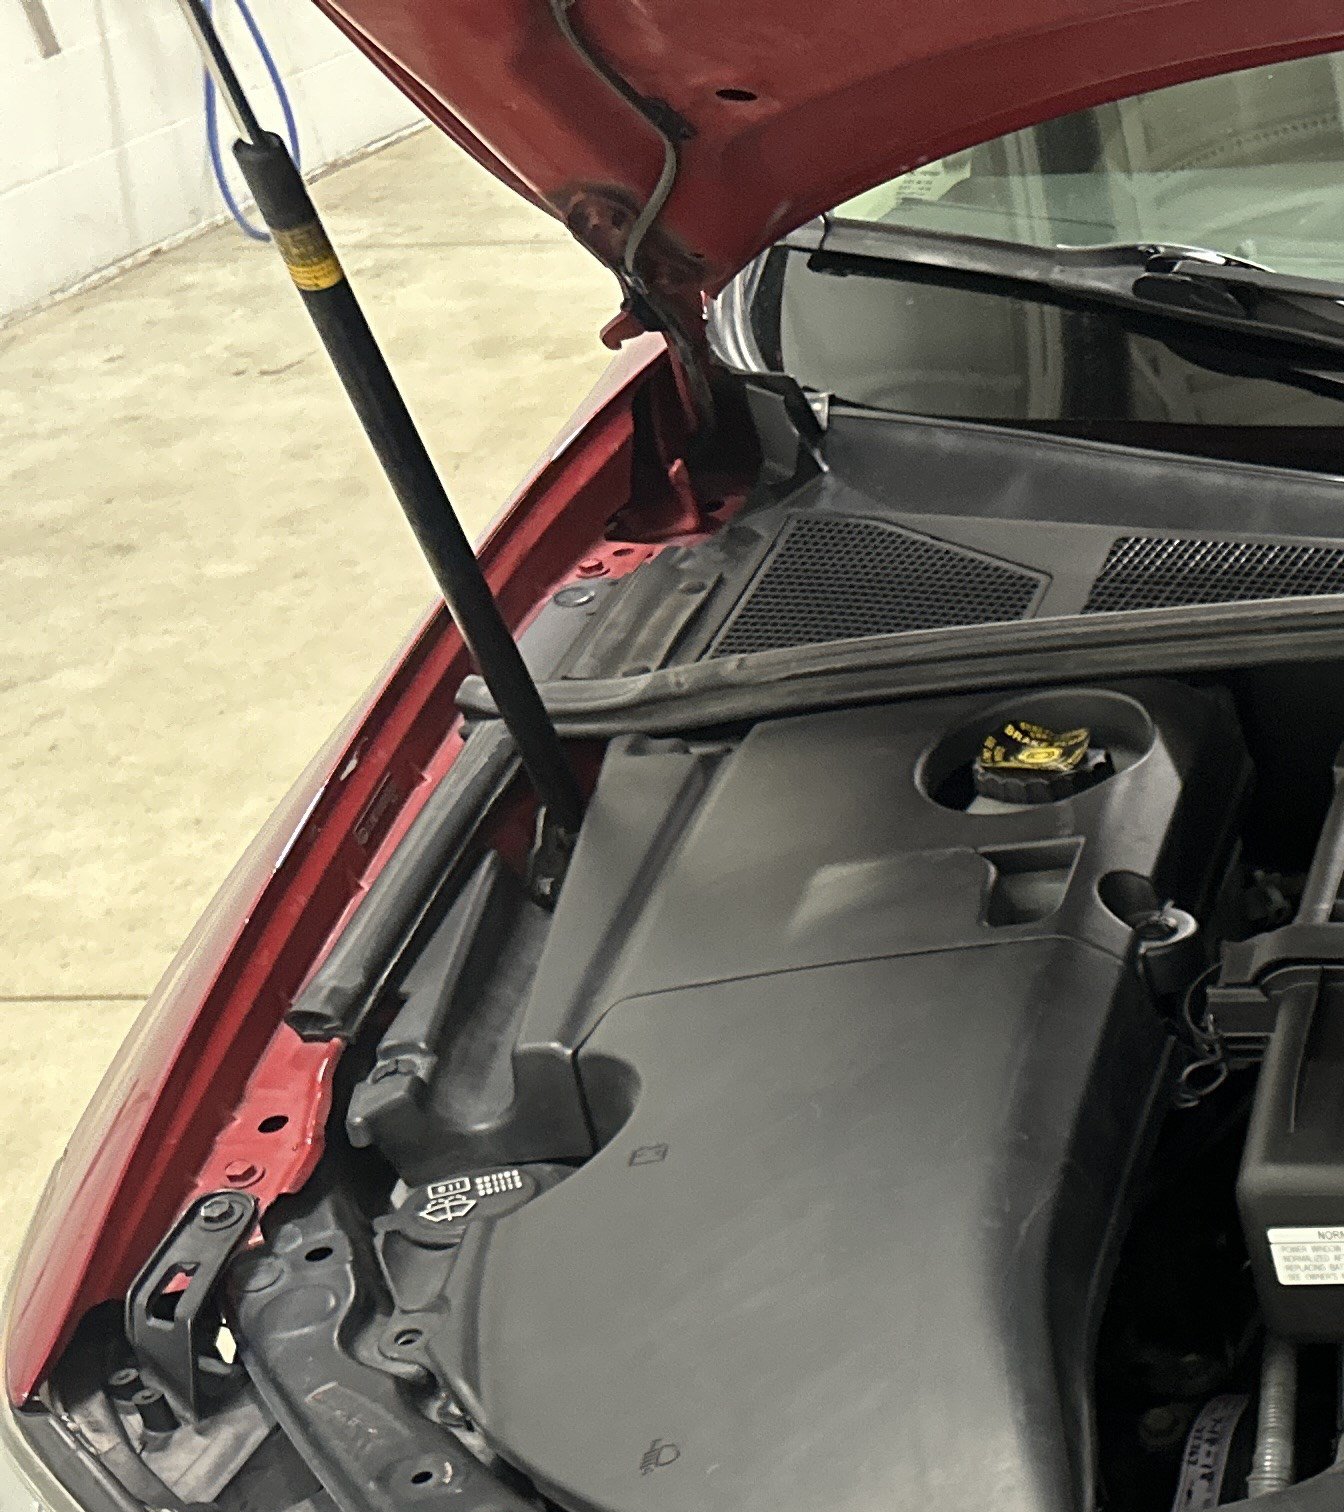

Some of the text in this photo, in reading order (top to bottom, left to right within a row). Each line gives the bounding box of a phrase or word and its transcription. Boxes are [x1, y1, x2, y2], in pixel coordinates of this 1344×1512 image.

[1281, 1244, 1308, 1253] POWER
[1283, 1253, 1330, 1263] NORMALIZED
[1285, 1262, 1327, 1272] REPLACING
